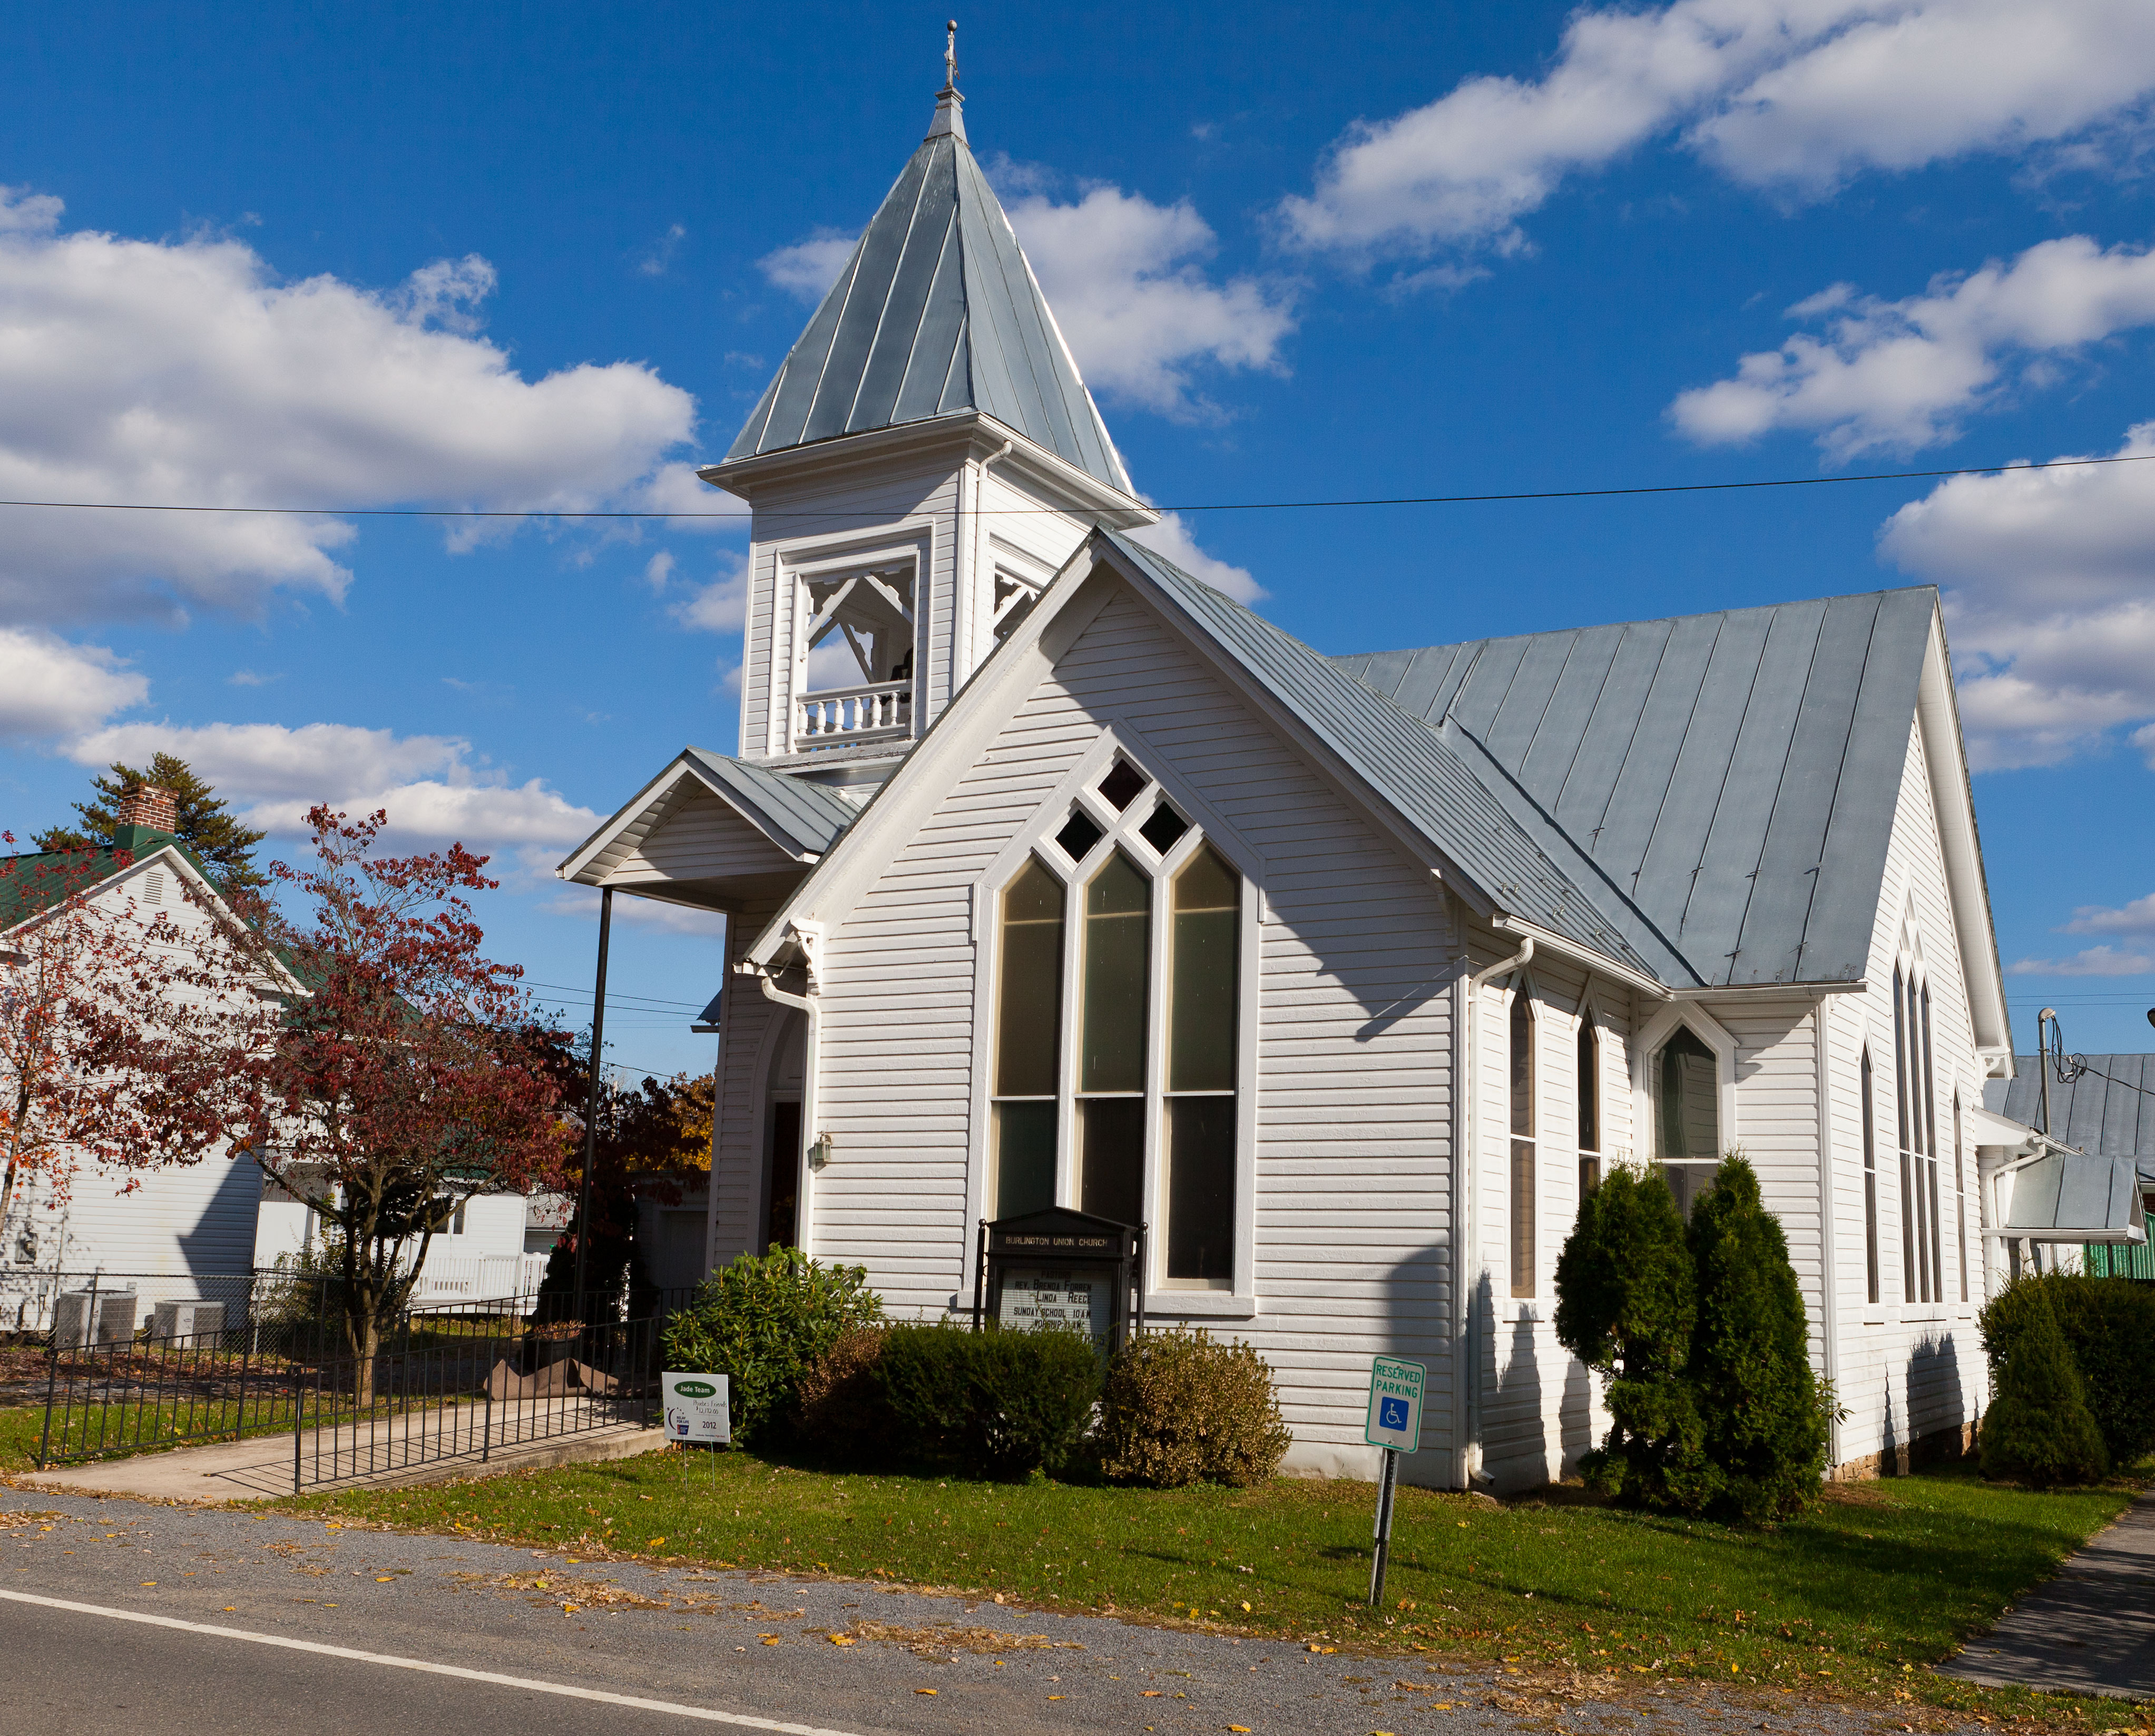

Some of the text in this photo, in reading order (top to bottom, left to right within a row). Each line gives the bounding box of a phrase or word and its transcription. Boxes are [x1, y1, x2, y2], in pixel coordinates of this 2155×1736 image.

[1006, 1237, 1108, 1247] BURLINGTON UNION CHURCH
[1015, 1281, 1030, 1289] REV.
[1033, 1279, 1060, 1290] BRENDA
[1036, 1291, 1092, 1304] LINDA REECE
[1014, 1307, 1039, 1316] SUNDAY
[1041, 1308, 1066, 1318] SCHOOL
[1376, 1365, 1421, 1383] RESERVED
[1376, 1380, 1418, 1398] PARKING
